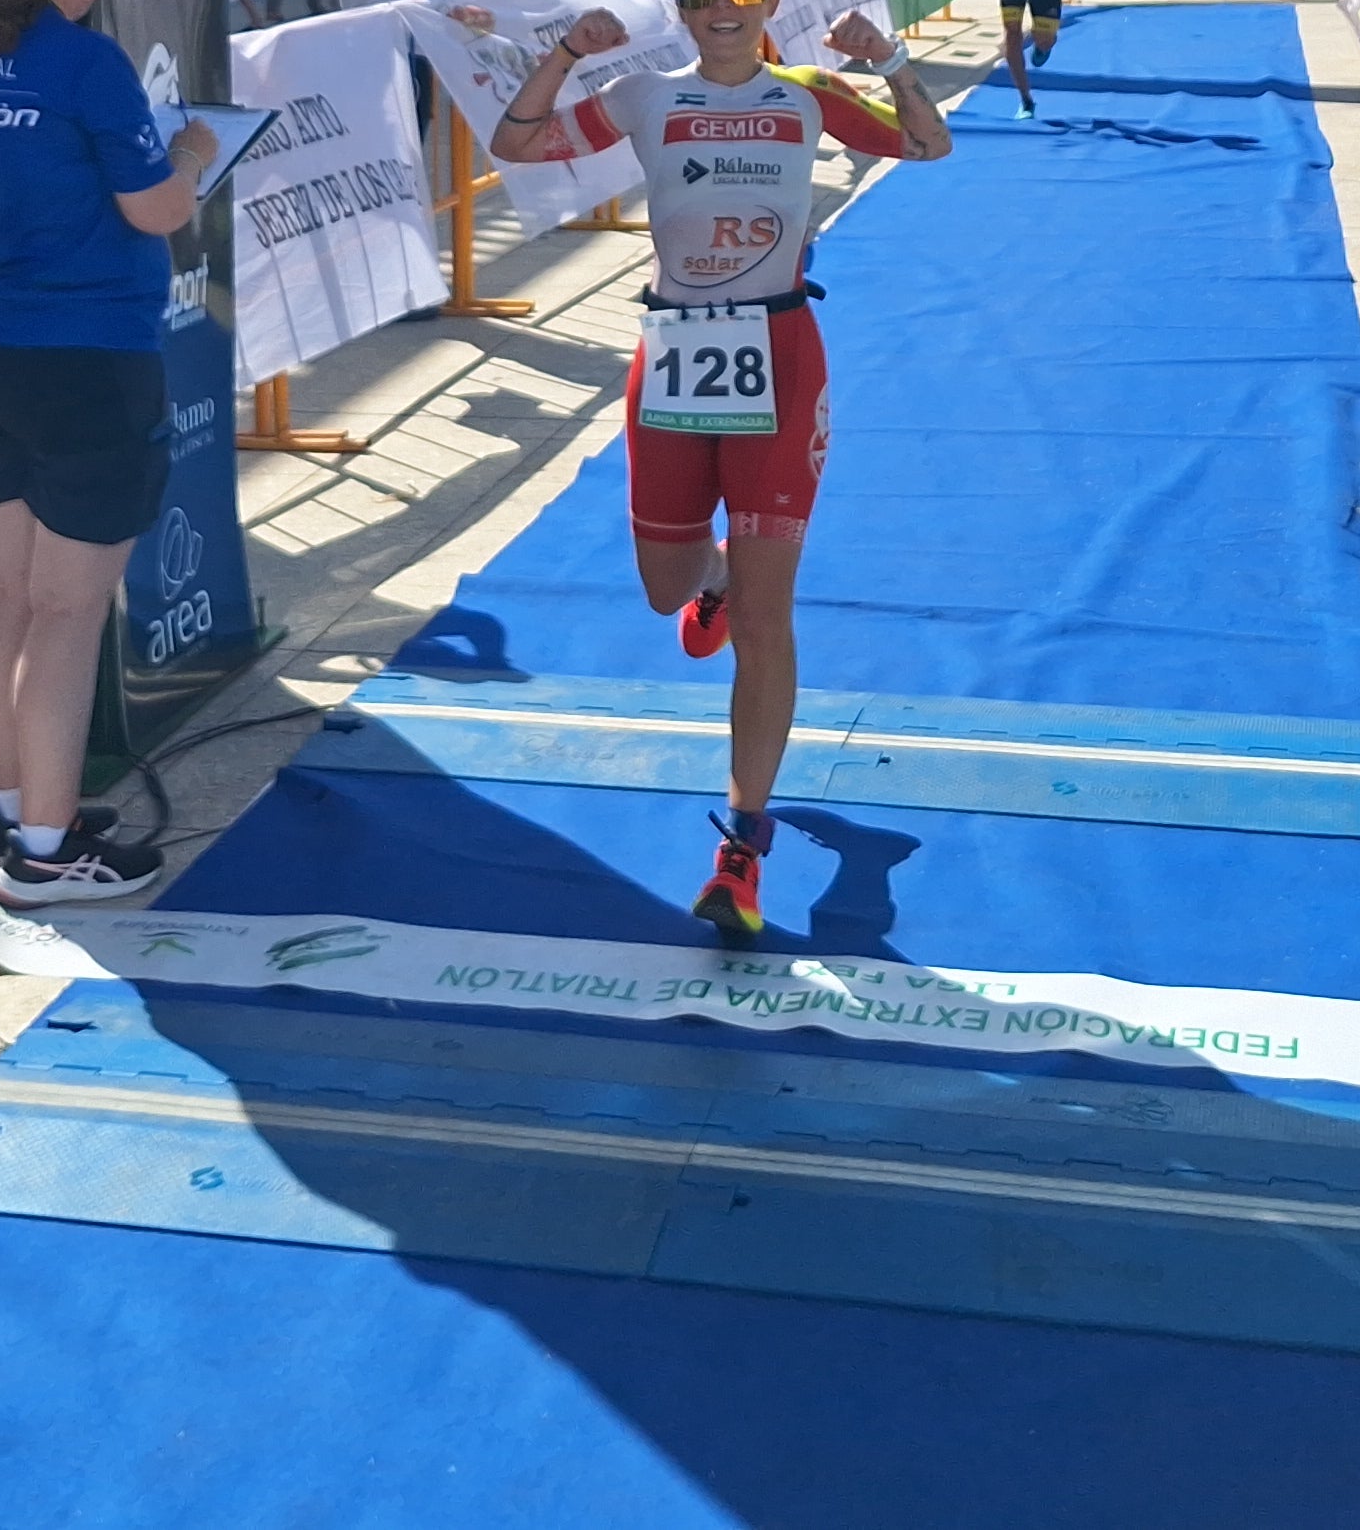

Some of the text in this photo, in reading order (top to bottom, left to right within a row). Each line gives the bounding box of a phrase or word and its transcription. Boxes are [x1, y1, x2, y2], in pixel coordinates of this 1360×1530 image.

[688, 116, 777, 140] GEMIO
[713, 156, 782, 176] Bálamo
[242, 182, 325, 250] JEREZ
[310, 173, 355, 224] DE
[341, 162, 393, 213] LOS
[709, 215, 778, 249] RS
[683, 254, 745, 272] solar
[653, 345, 767, 398] 128
[146, 589, 213, 664] area
[903, 976, 1018, 997] LIGA
[435, 962, 1300, 1061] TRIATLÓN DE EXTREMEÑA FEDERACIÓN
